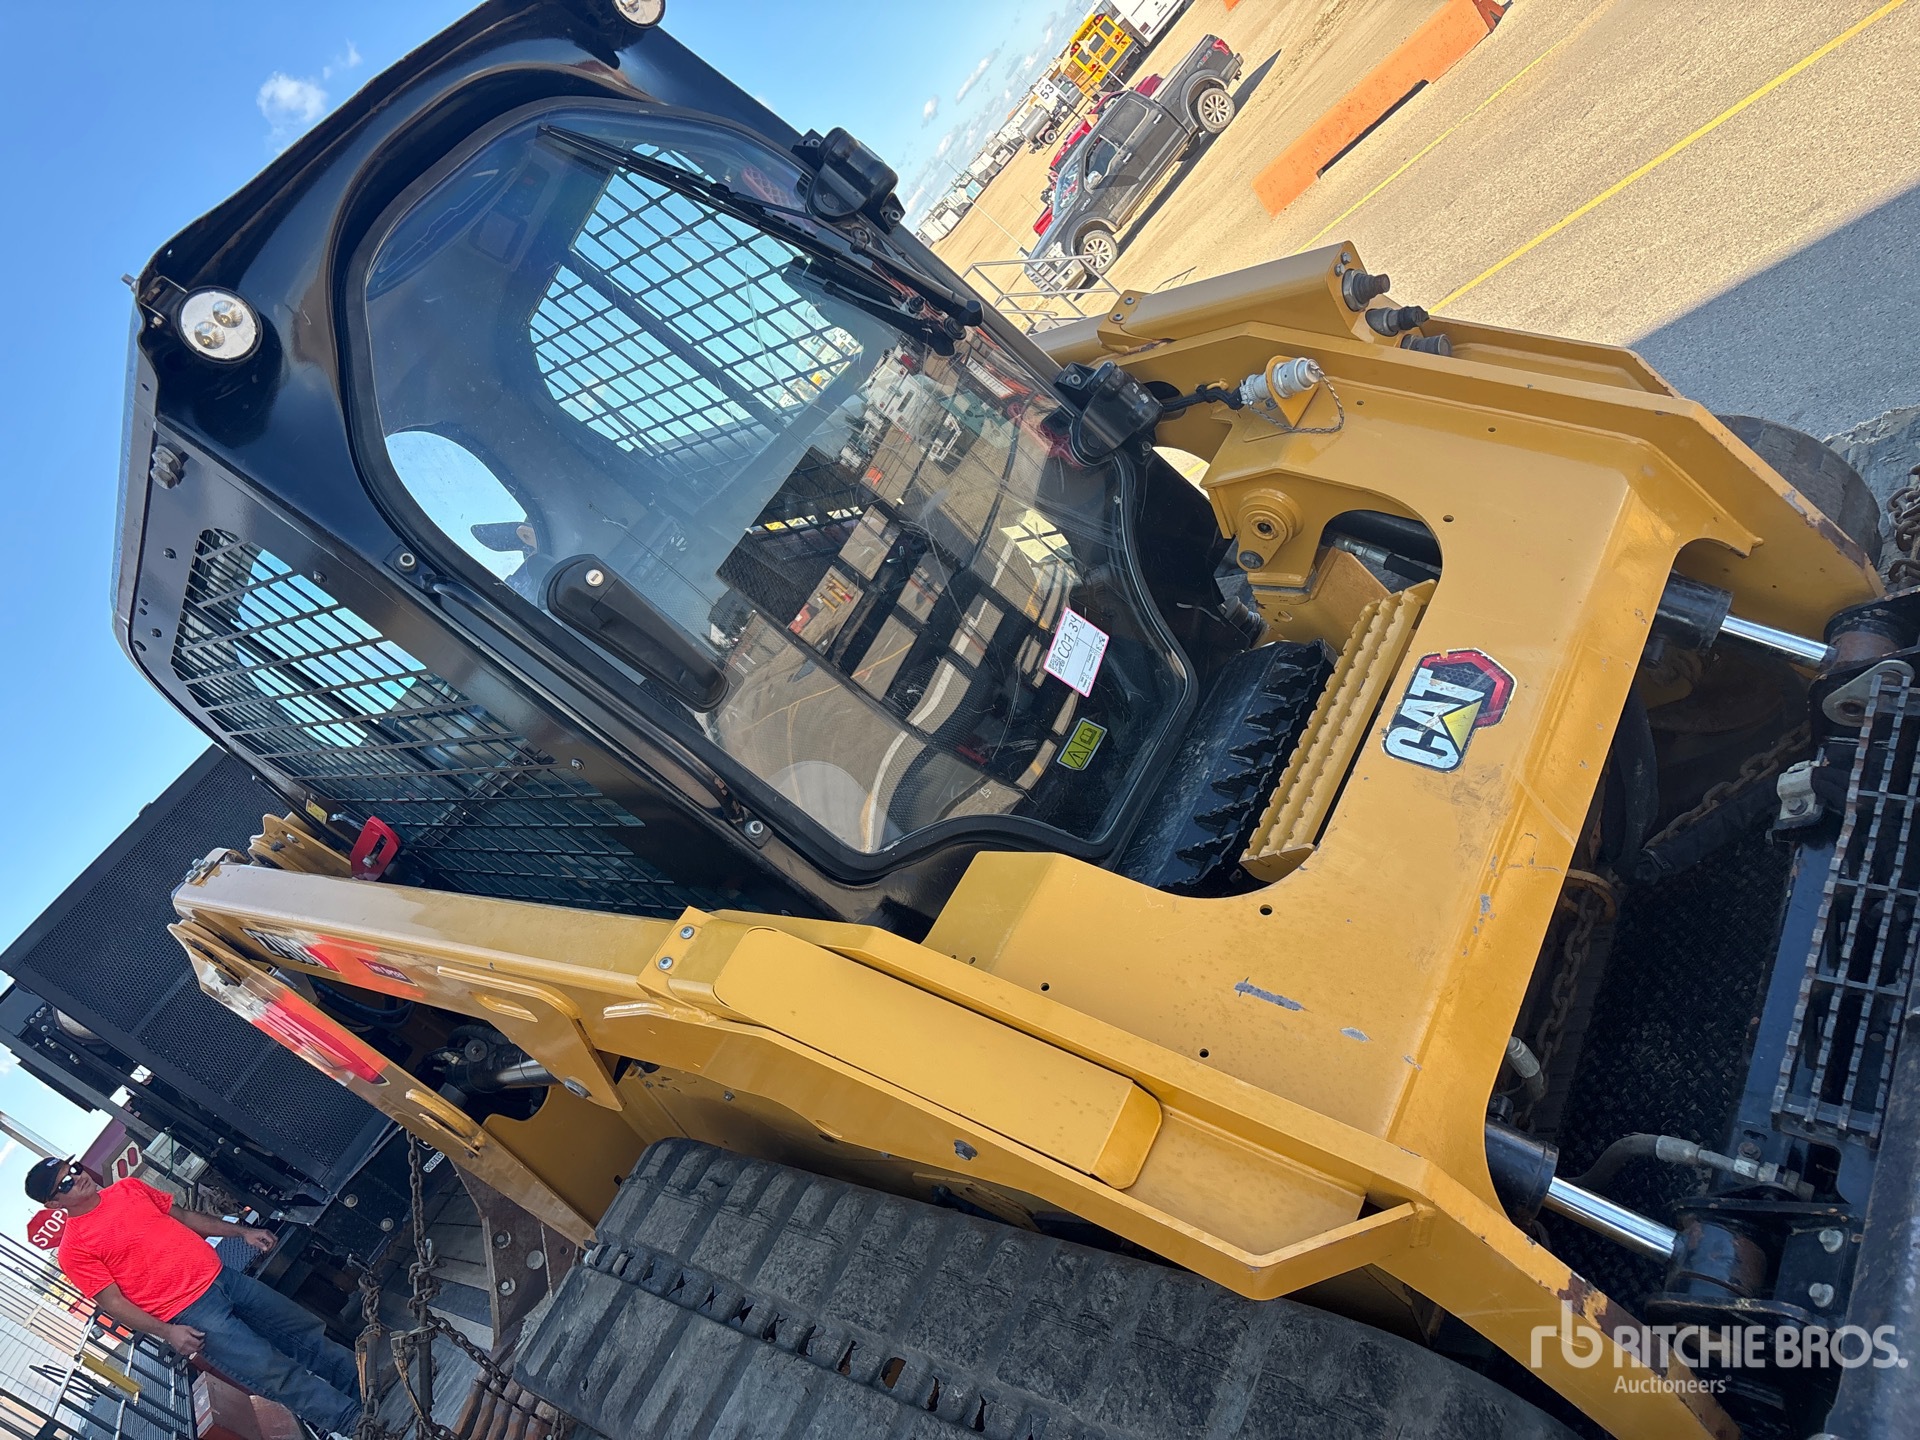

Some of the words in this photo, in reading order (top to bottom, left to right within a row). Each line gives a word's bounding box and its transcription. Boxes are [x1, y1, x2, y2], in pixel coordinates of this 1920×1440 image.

[1040, 84, 1055, 99] 53
[1385, 667, 1485, 769] CAT
[32, 1208, 68, 1247] STOP
